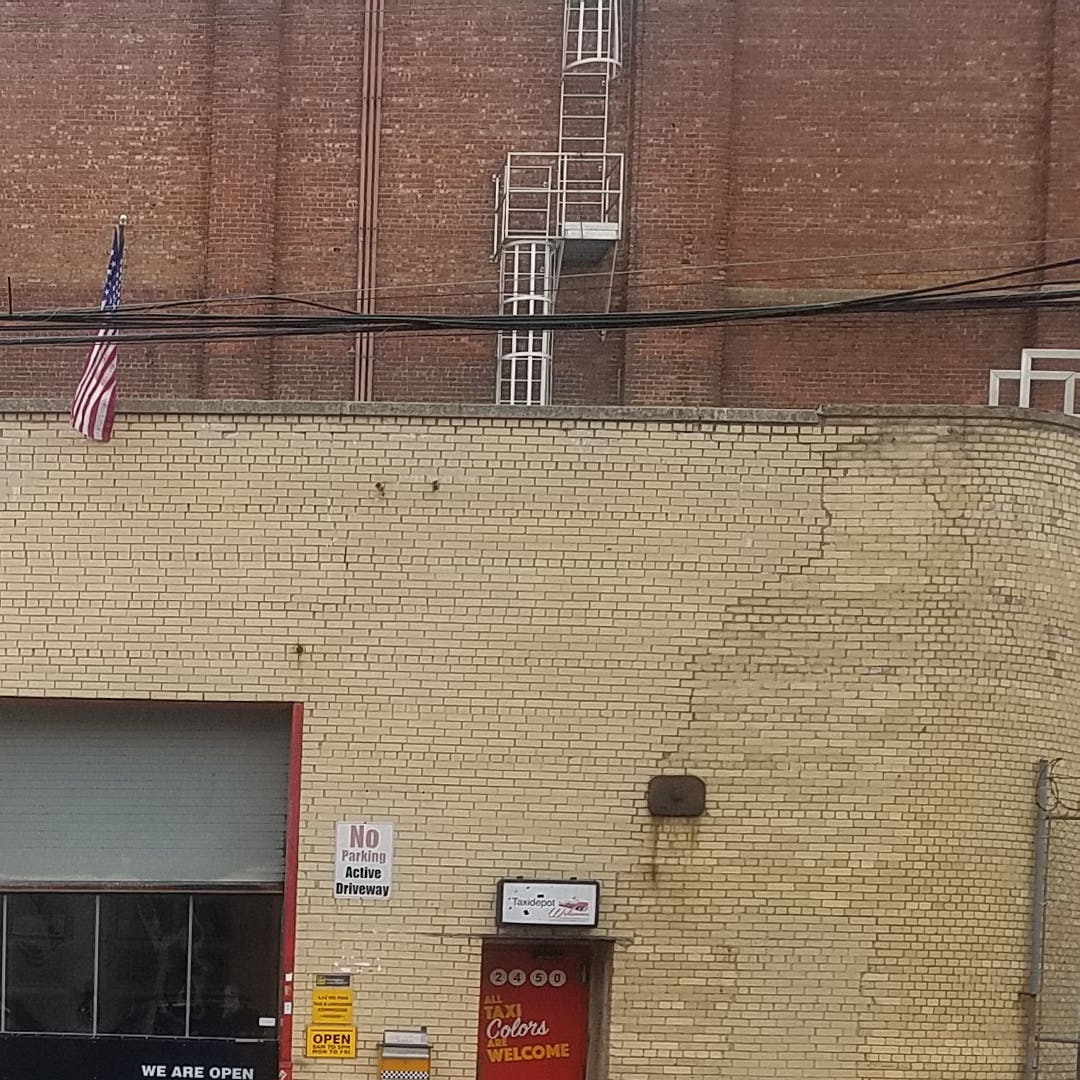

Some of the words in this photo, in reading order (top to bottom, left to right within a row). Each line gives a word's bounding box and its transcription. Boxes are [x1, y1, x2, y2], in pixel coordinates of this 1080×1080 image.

[350, 825, 379, 848] No
[341, 850, 386, 864] Parking
[345, 866, 381, 879] Active
[336, 882, 389, 897] Driveway
[512, 897, 555, 908] Taxidepot
[492, 970, 564, 984] 2450
[484, 995, 503, 1004] ALL
[484, 1004, 522, 1019] TAXI
[487, 1018, 549, 1039] Colors
[313, 1034, 351, 1044] OPEN
[487, 1039, 507, 1047] ARE
[487, 1043, 570, 1062] WELCOME
[141, 1065, 167, 1077] WE
[171, 1066, 204, 1078] ARE
[209, 1067, 254, 1080] OPEN
